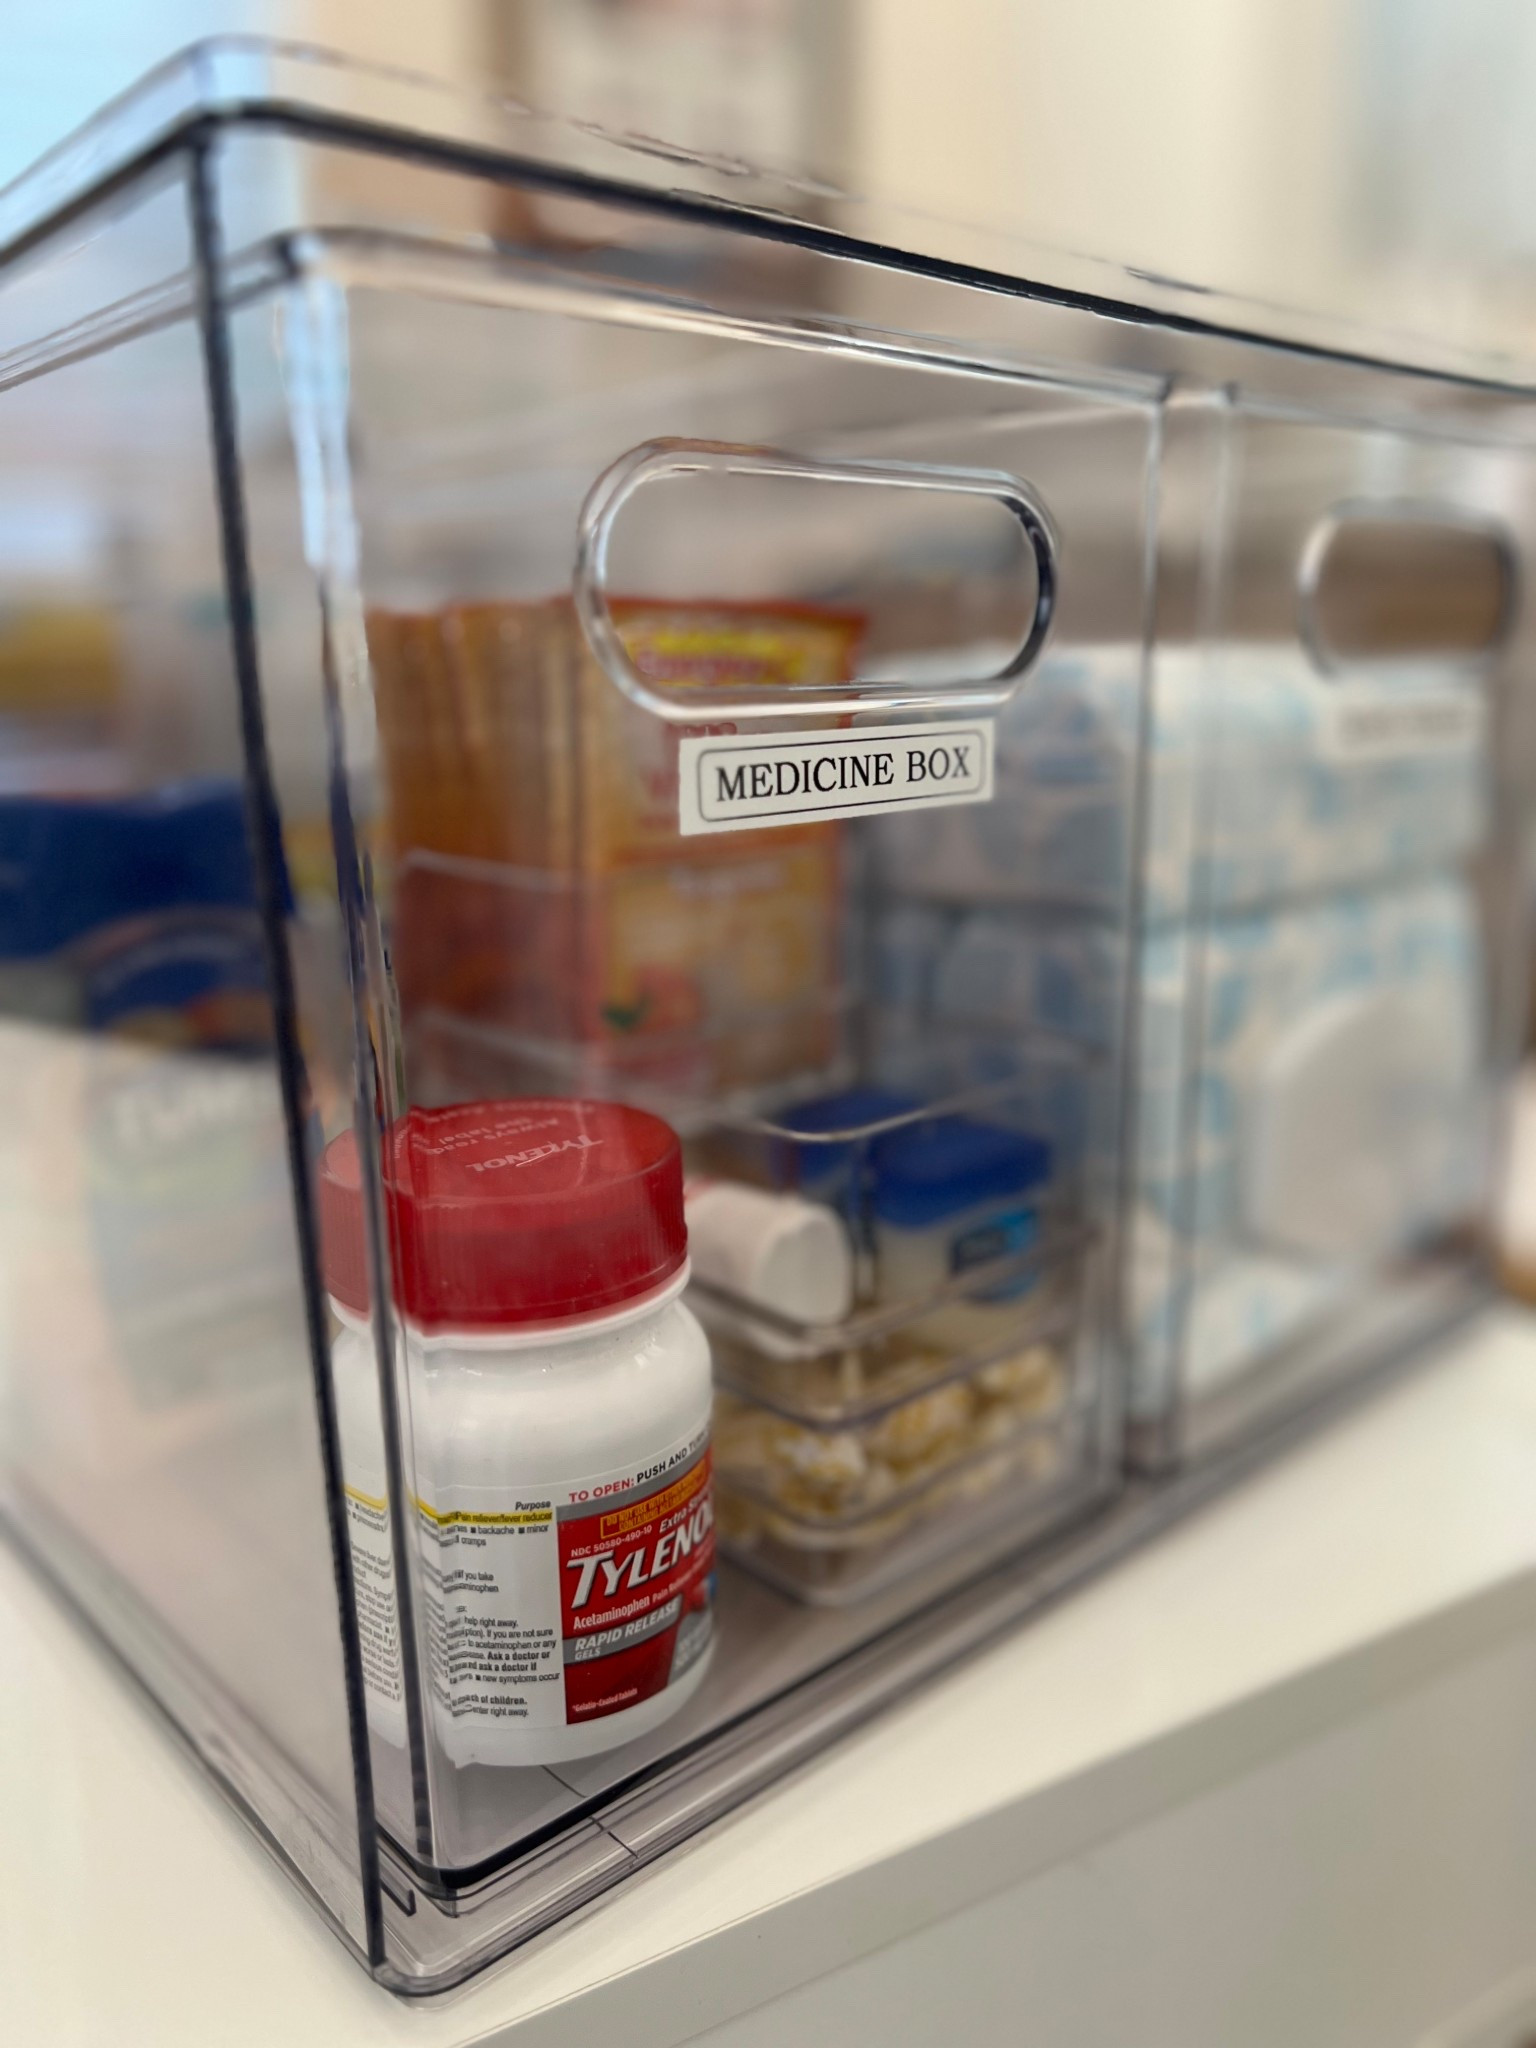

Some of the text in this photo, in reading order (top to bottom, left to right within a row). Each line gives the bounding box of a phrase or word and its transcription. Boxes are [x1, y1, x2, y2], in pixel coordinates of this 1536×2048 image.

[715, 745, 971, 802] MEDICINE BOX
[465, 1133, 603, 1173] TYLENOL
[568, 1490, 590, 1503] TO
[592, 1477, 635, 1498] OPEN:
[636, 1461, 667, 1483] PUSH
[667, 1447, 688, 1468] AND
[514, 1500, 551, 1512] Purpose
[659, 1506, 688, 1534] Extra
[477, 1525, 515, 1535] backache
[526, 1523, 549, 1533] minor
[571, 1524, 653, 1558] NDC 50580-490-10
[566, 1499, 714, 1610] TYLENO
[465, 1571, 477, 1581] you
[477, 1571, 494, 1581] take
[573, 1588, 668, 1630] Acetaminophen Pain
[479, 1617, 496, 1629] right
[497, 1618, 519, 1630] away.
[574, 1598, 680, 1652] RAPID RELEASE
[493, 1630, 507, 1640] you
[508, 1630, 521, 1639] are
[522, 1629, 535, 1638] not
[536, 1628, 554, 1638] sure
[475, 1639, 532, 1651] acetaminophen
[533, 1641, 541, 1649] or
[542, 1639, 557, 1650] any
[487, 1651, 503, 1661] Ask
[504, 1653, 511, 1661] a
[512, 1651, 539, 1661] doctor
[541, 1651, 551, 1660] or
[574, 1646, 601, 1662] GELS
[479, 1662, 493, 1671] ask
[494, 1664, 500, 1672] a
[501, 1662, 529, 1672] doctor
[530, 1661, 537, 1671] if
[482, 1674, 498, 1683] new
[499, 1674, 538, 1685] symptoms
[538, 1672, 560, 1682] occur
[480, 1694, 489, 1704] of
[490, 1695, 528, 1706] children.
[490, 1706, 507, 1718] right
[508, 1709, 529, 1718] away.
